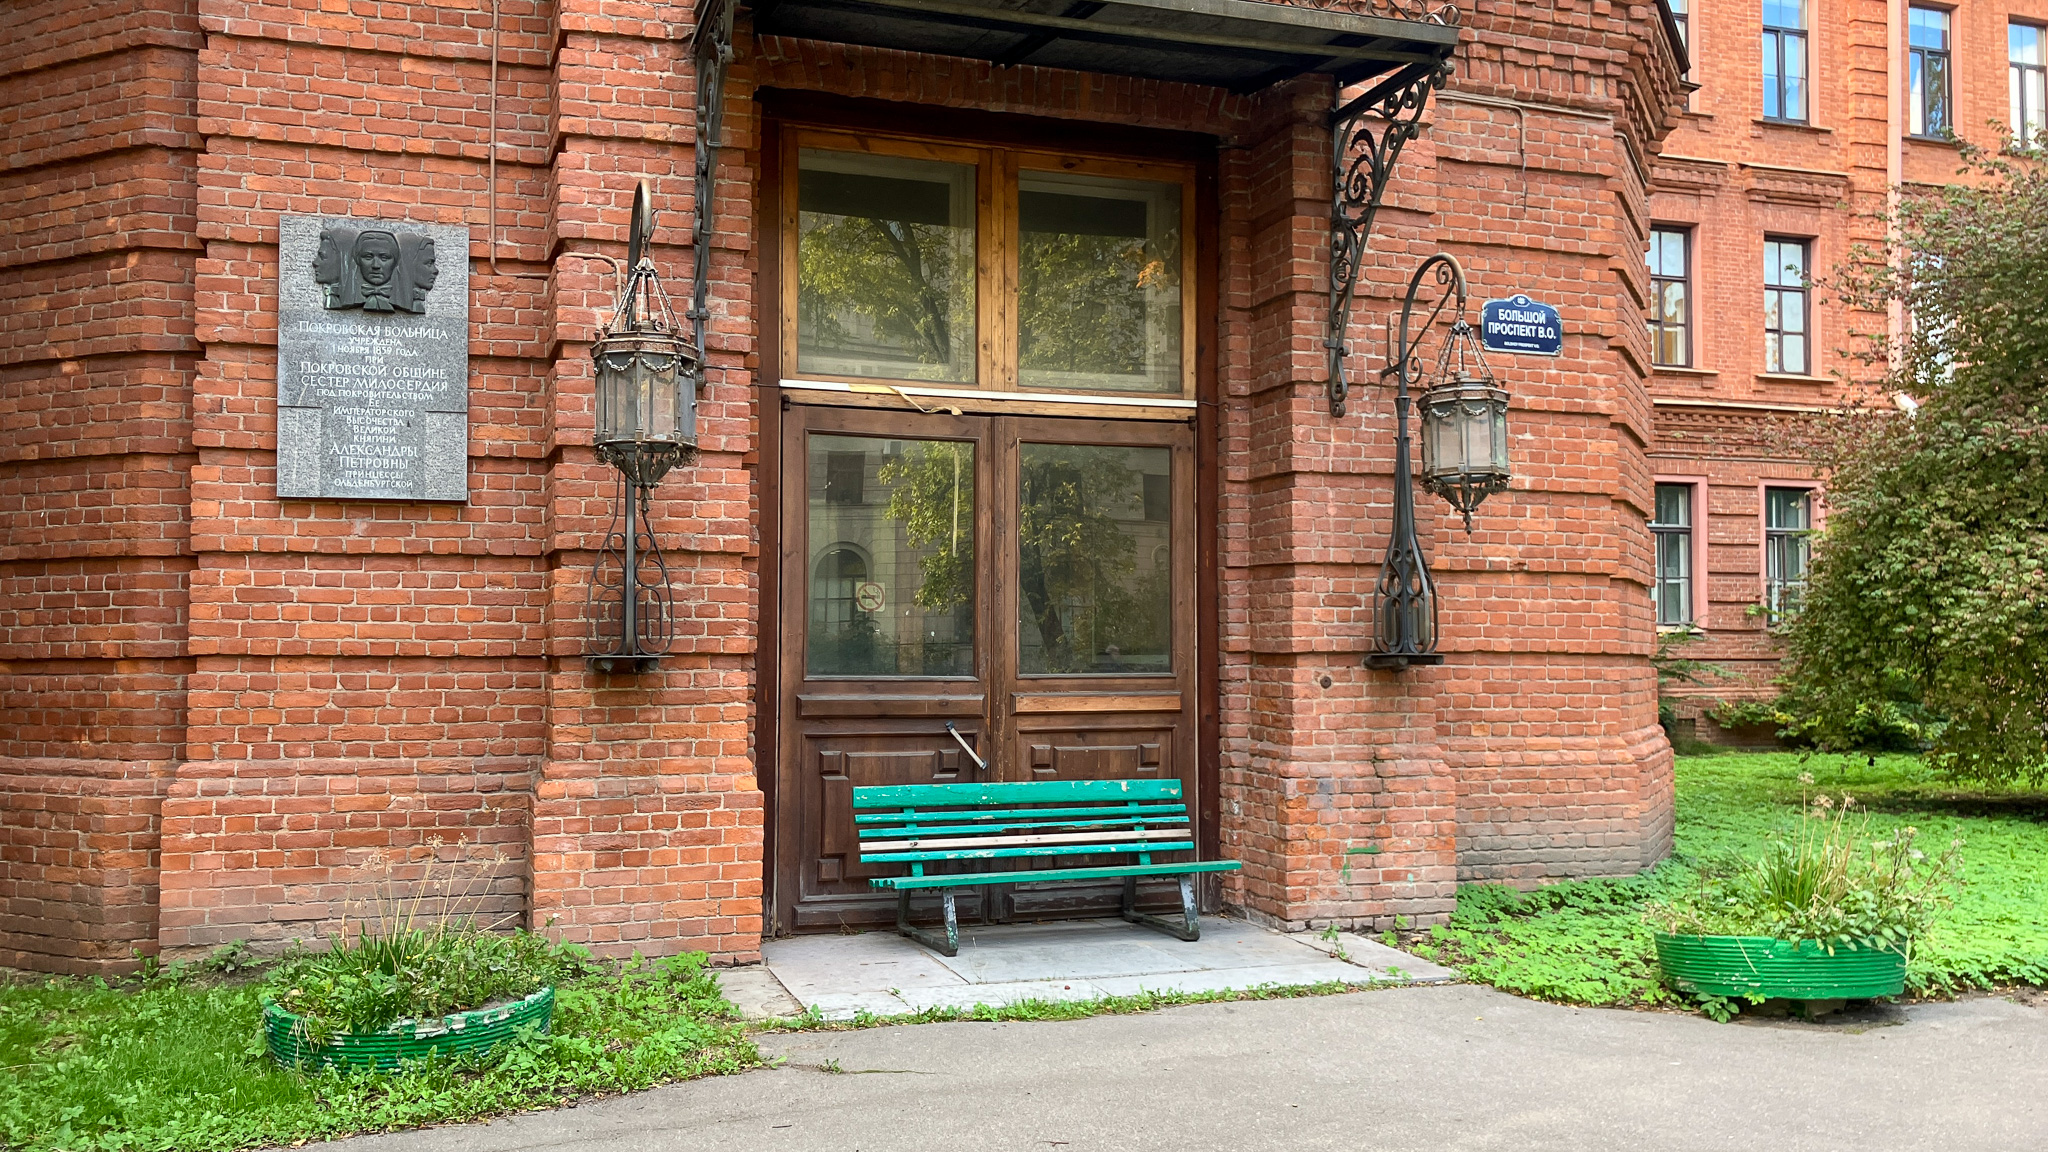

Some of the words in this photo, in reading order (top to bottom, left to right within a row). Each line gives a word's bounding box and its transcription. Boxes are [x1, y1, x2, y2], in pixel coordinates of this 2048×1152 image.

[1498, 308, 1546, 325] БОЛЬШОЙ
[299, 320, 381, 336] ПОКРОВСКАЯ
[384, 326, 449, 341] БОЛЬНИЦА
[1488, 321, 1537, 338] ПРОСПЕКТ
[1538, 327, 1557, 340] В.О.
[350, 337, 402, 346] УЧРЕЖДЕНА
[337, 345, 370, 356] НОЯБРЯ
[373, 346, 392, 356] 1859
[395, 348, 418, 357] ГОДА
[365, 355, 384, 364] ПРИ
[300, 361, 387, 378] ПОКРОВСКОЙ
[393, 366, 447, 380] ОБЩИНЕ
[301, 375, 350, 389] СЕСТЕР
[352, 377, 448, 392] МИЛОСЕРДИЯ
[316, 388, 336, 397] ПОД
[338, 389, 434, 401] ПОКРОВИТЕЛЬСТВОМ
[333, 405, 415, 417] ИМПЕРАТОРСКОГО
[346, 416, 405, 427] ВЫСОЧЕСТВА
[353, 424, 396, 435] ВЕЛИКОЙ
[353, 434, 397, 444] КНЯГИНИ
[329, 441, 419, 458] АЛЕКСАНДРЫ
[339, 455, 408, 470] ПЕТРОВНЫ
[345, 470, 403, 479] ПРИНЦЕССЫ
[333, 478, 413, 489] ОЛЬДЕНБУРГСКОЙ
